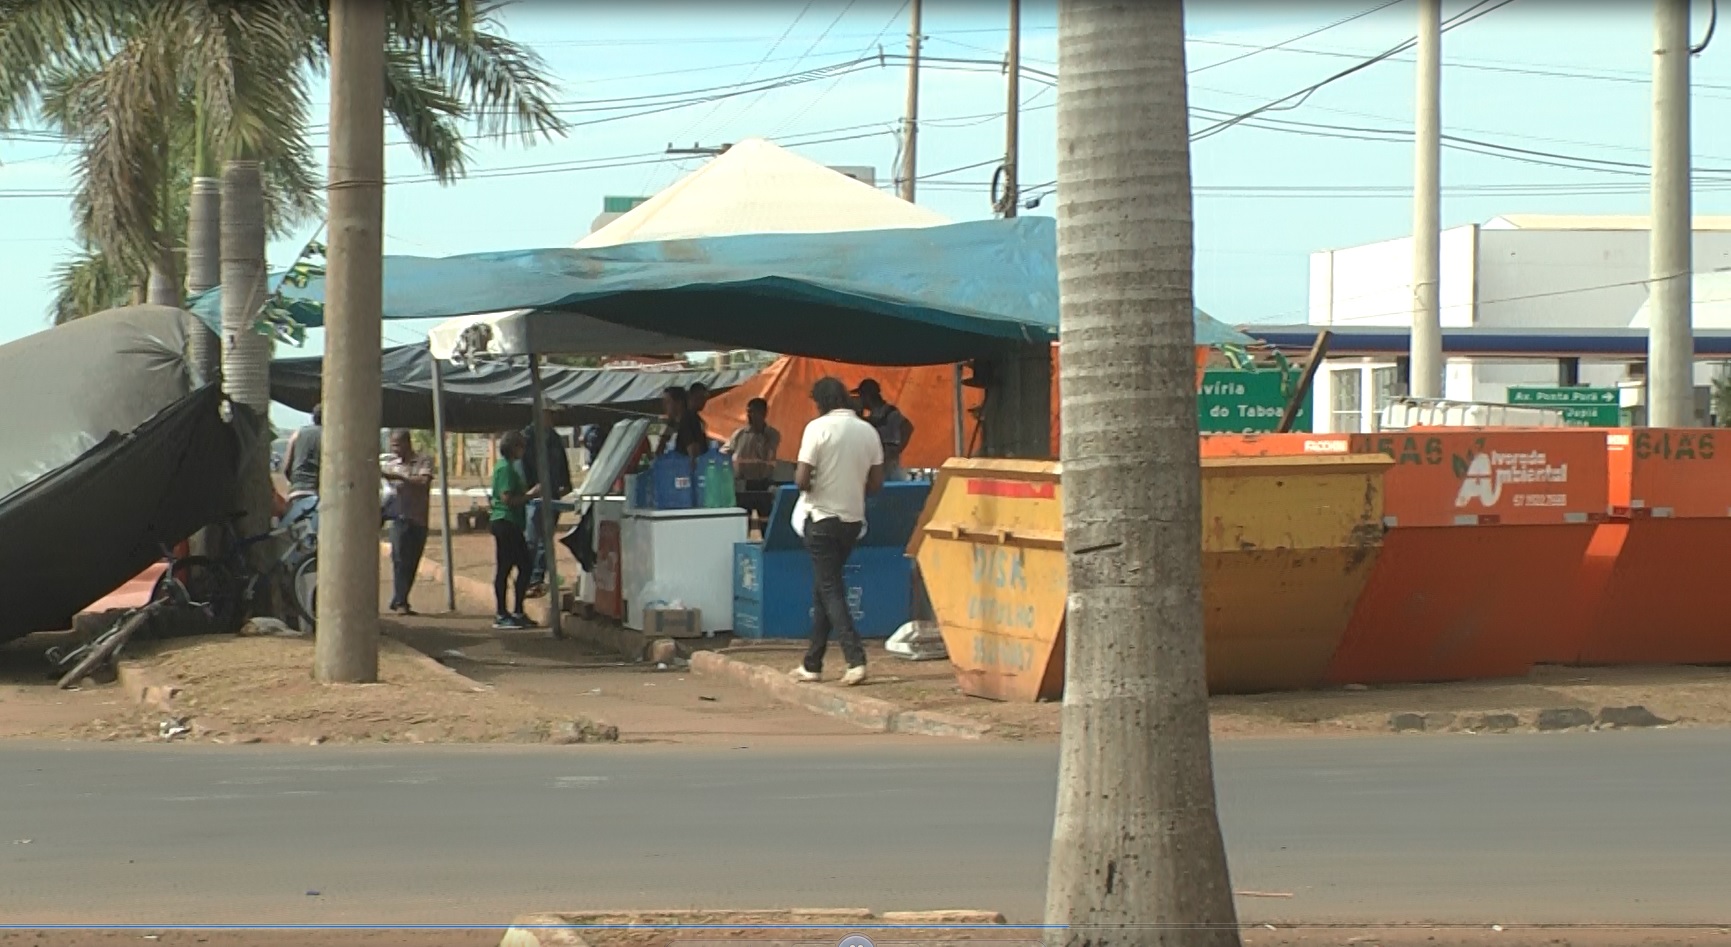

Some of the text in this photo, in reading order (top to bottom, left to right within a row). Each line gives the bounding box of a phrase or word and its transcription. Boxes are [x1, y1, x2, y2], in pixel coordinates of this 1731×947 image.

[1209, 405, 1230, 417] do
[1237, 405, 1304, 417] Taboao
[1635, 432, 1714, 460] 64A6
